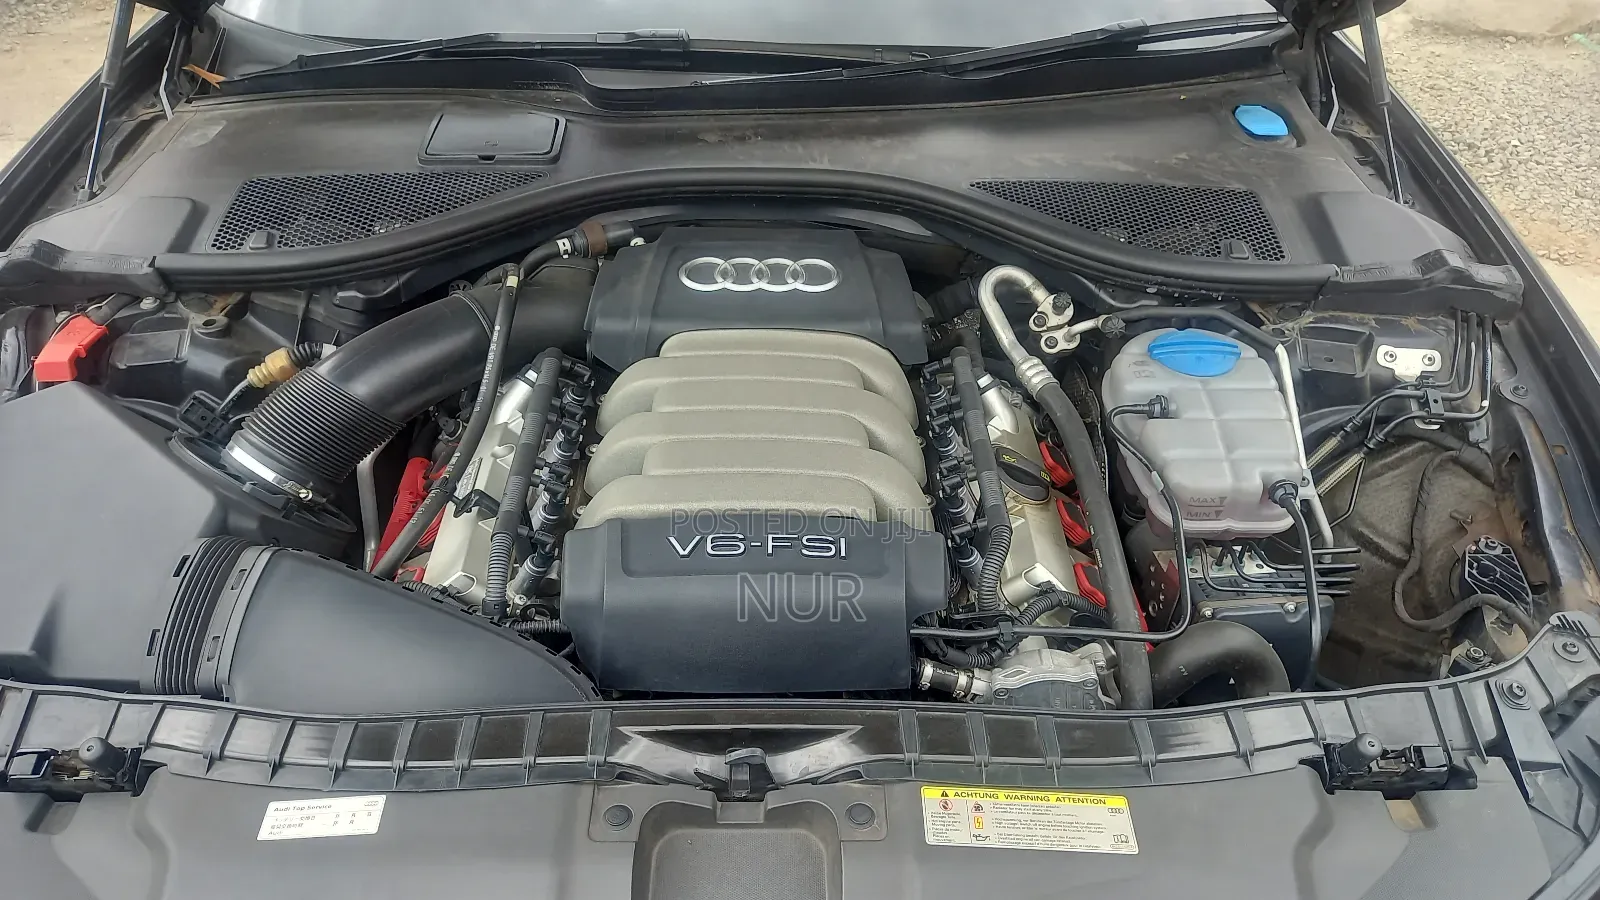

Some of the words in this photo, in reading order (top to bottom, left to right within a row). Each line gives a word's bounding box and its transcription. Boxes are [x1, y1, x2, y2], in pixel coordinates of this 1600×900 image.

[1189, 496, 1216, 504] MAX
[953, 791, 999, 799] ACHTUNG
[1003, 793, 1050, 802] WARNING
[1055, 796, 1107, 805] ATTENTION
